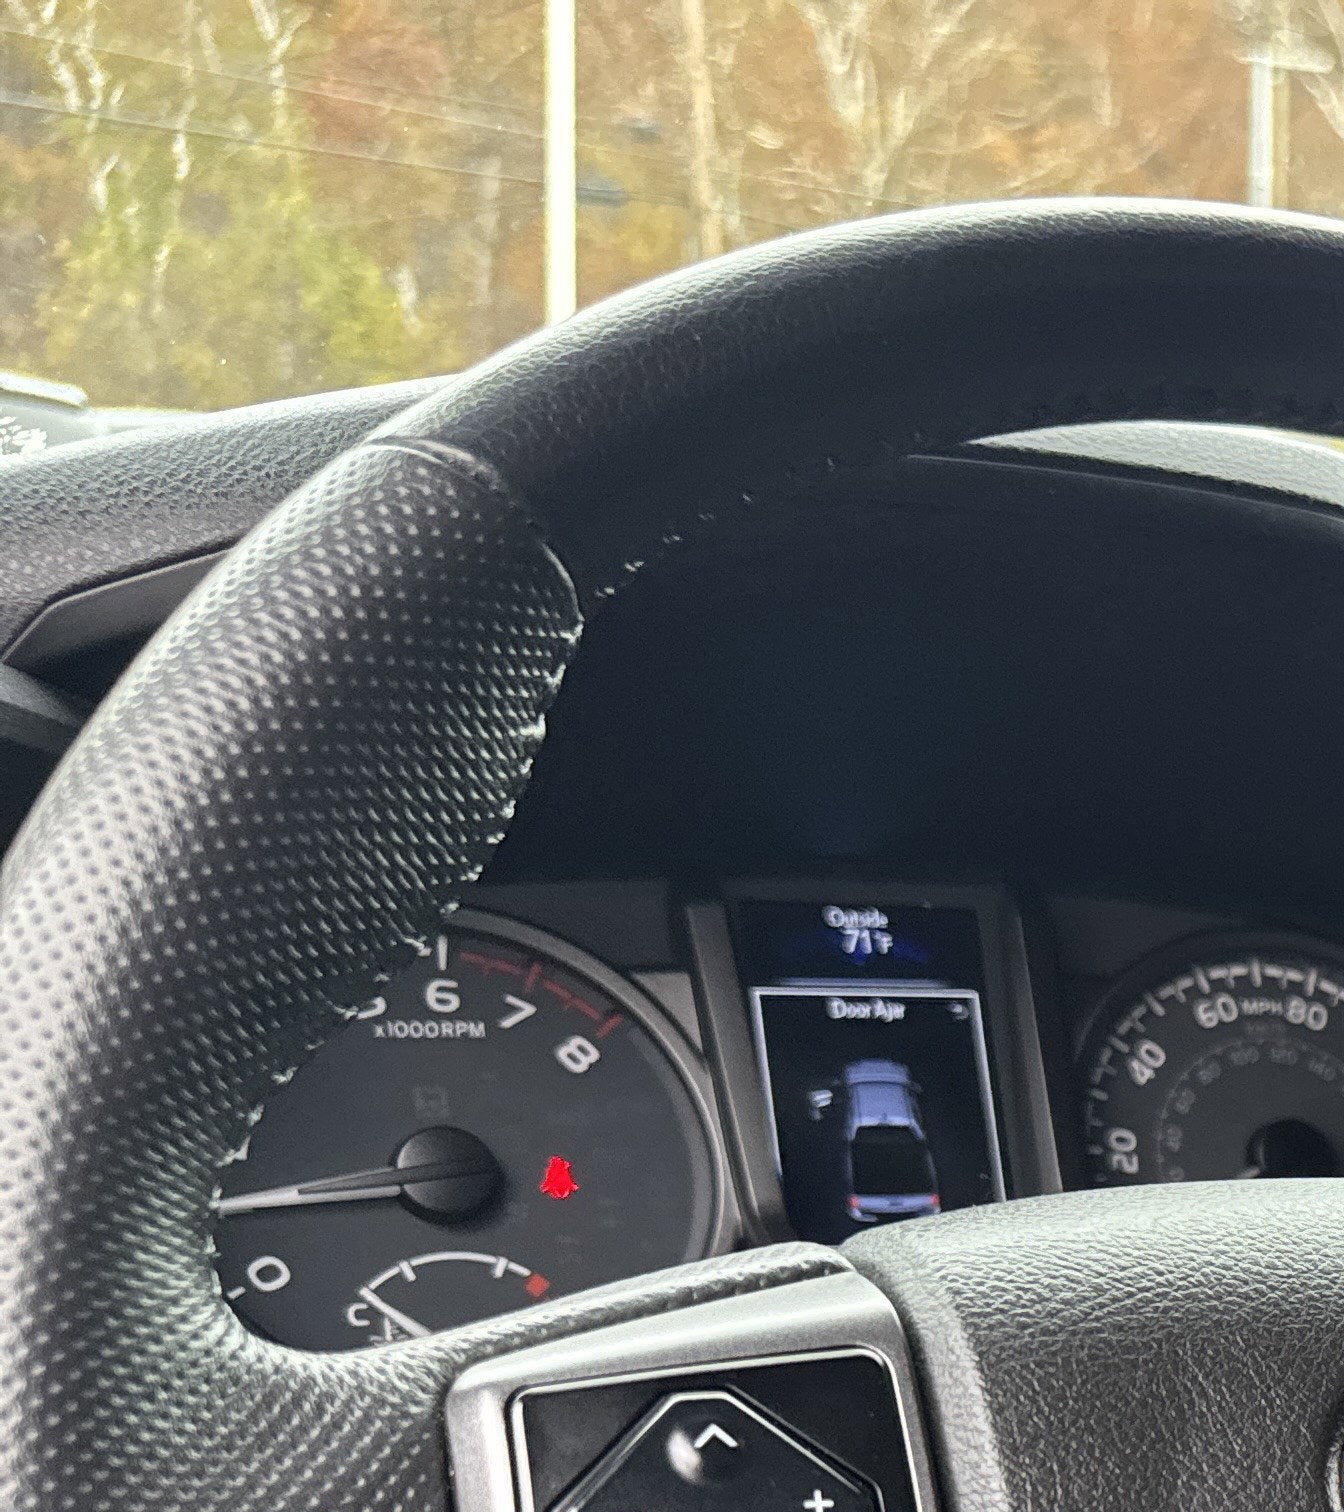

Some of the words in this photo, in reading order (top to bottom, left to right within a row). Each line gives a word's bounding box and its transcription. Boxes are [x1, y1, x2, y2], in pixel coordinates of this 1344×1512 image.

[425, 979, 461, 1013] 6
[498, 994, 538, 1029] 7
[1194, 992, 1239, 1029] 60
[1242, 997, 1282, 1016] MPH
[1284, 994, 1329, 1031] 80
[554, 1035, 599, 1073] 8
[1128, 1040, 1167, 1085] 40
[1107, 1127, 1140, 1174] 20
[247, 1255, 292, 1292] 0
